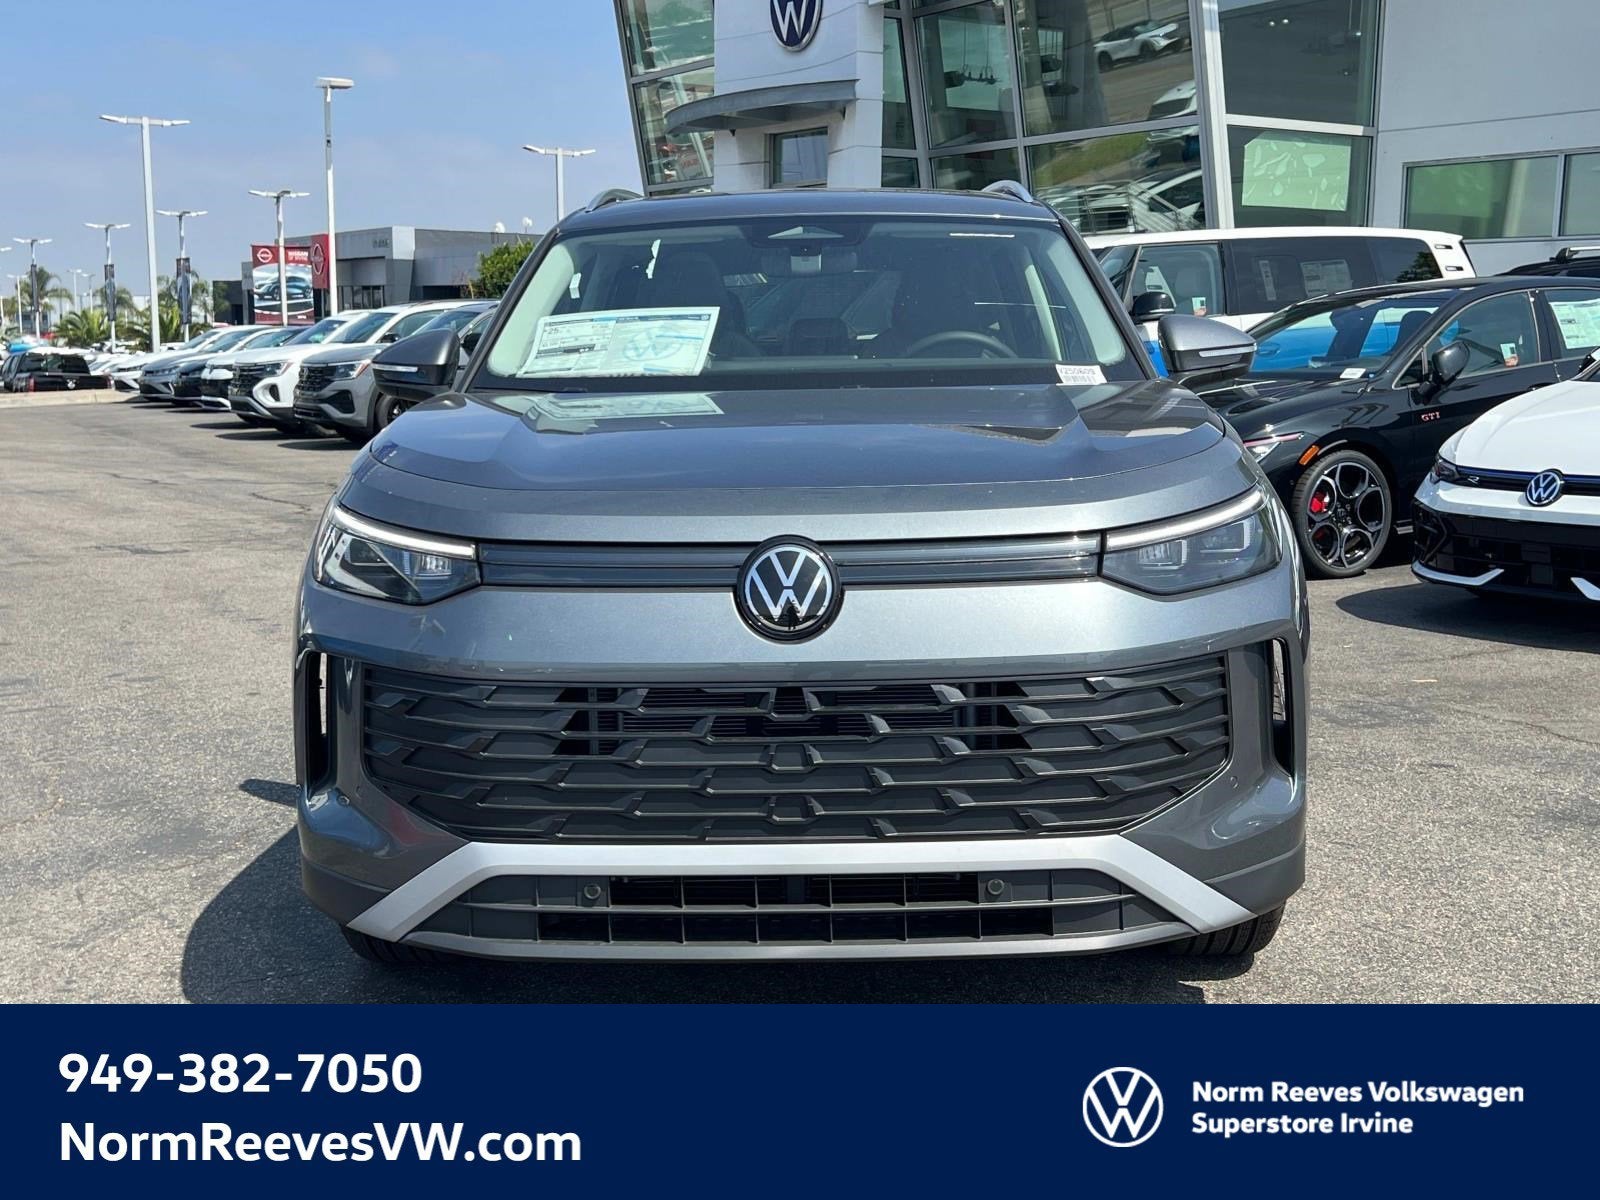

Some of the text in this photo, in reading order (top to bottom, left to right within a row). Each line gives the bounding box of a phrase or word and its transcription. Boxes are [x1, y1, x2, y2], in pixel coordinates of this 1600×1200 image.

[1421, 411, 1440, 421] GTI
[1527, 471, 1560, 505] VW
[745, 544, 832, 631] VW
